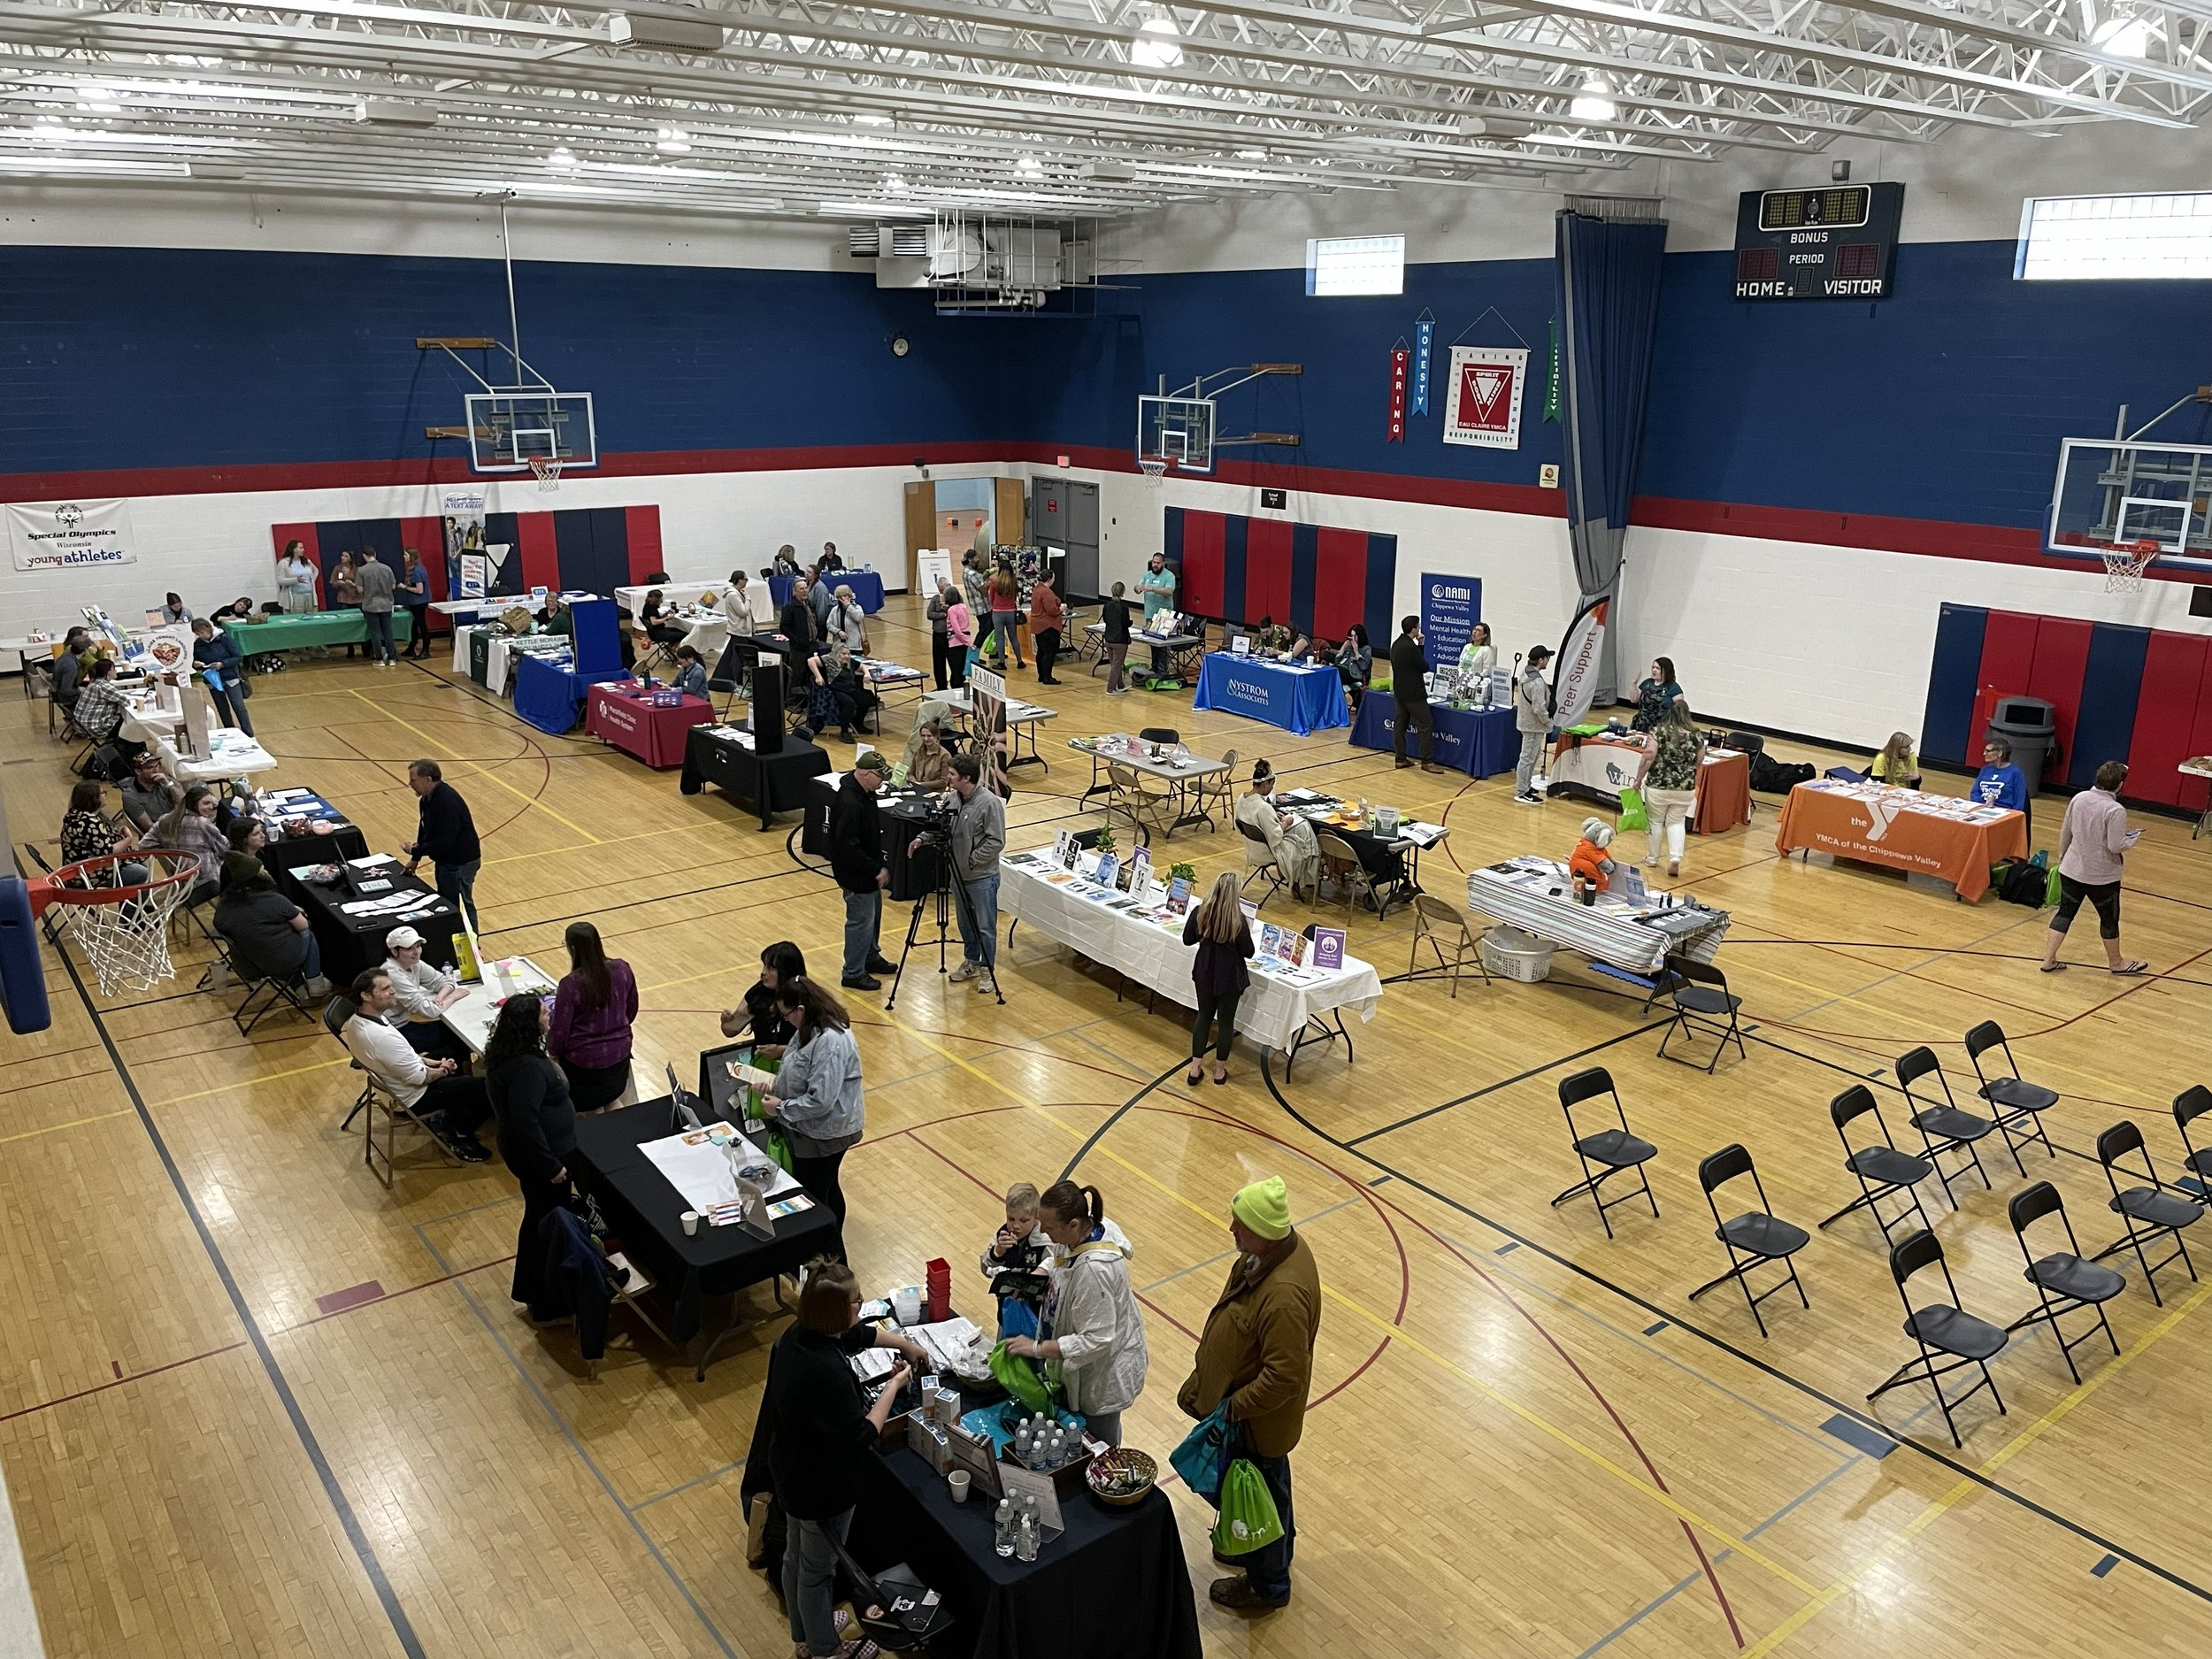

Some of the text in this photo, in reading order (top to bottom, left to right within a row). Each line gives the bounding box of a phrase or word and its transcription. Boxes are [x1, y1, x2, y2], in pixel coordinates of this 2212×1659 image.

[1790, 232, 1829, 244] BONUS
[1789, 253, 1824, 265] PERIOD
[1736, 281, 1786, 296] HOME
[1824, 279, 1883, 295] VISITOR
[1456, 352, 1523, 361] CARING
[1417, 323, 1430, 406] HONESTY
[1392, 352, 1404, 434] CARING
[1486, 380, 1502, 406] MIND
[1449, 431, 1513, 442] RESPONSIBILITY
[27, 529, 117, 541] Special Olympics
[27, 549, 122, 567] young athletes
[1445, 587, 1471, 601] NAMI
[1443, 616, 1471, 626] Mission
[1429, 624, 1450, 633] Mental
[1437, 634, 1467, 643] Education
[1437, 644, 1461, 653] Support
[974, 668, 1002, 690] FAMILY
[1557, 631, 1597, 716] Peer Support
[1230, 679, 1269, 698] NYSTROM
[1440, 733, 1461, 746] Valley
[1851, 817, 1868, 827] the
[1816, 833, 1839, 847] YMCA
[1853, 841, 1867, 851] the
[1914, 854, 1941, 869] Valley
